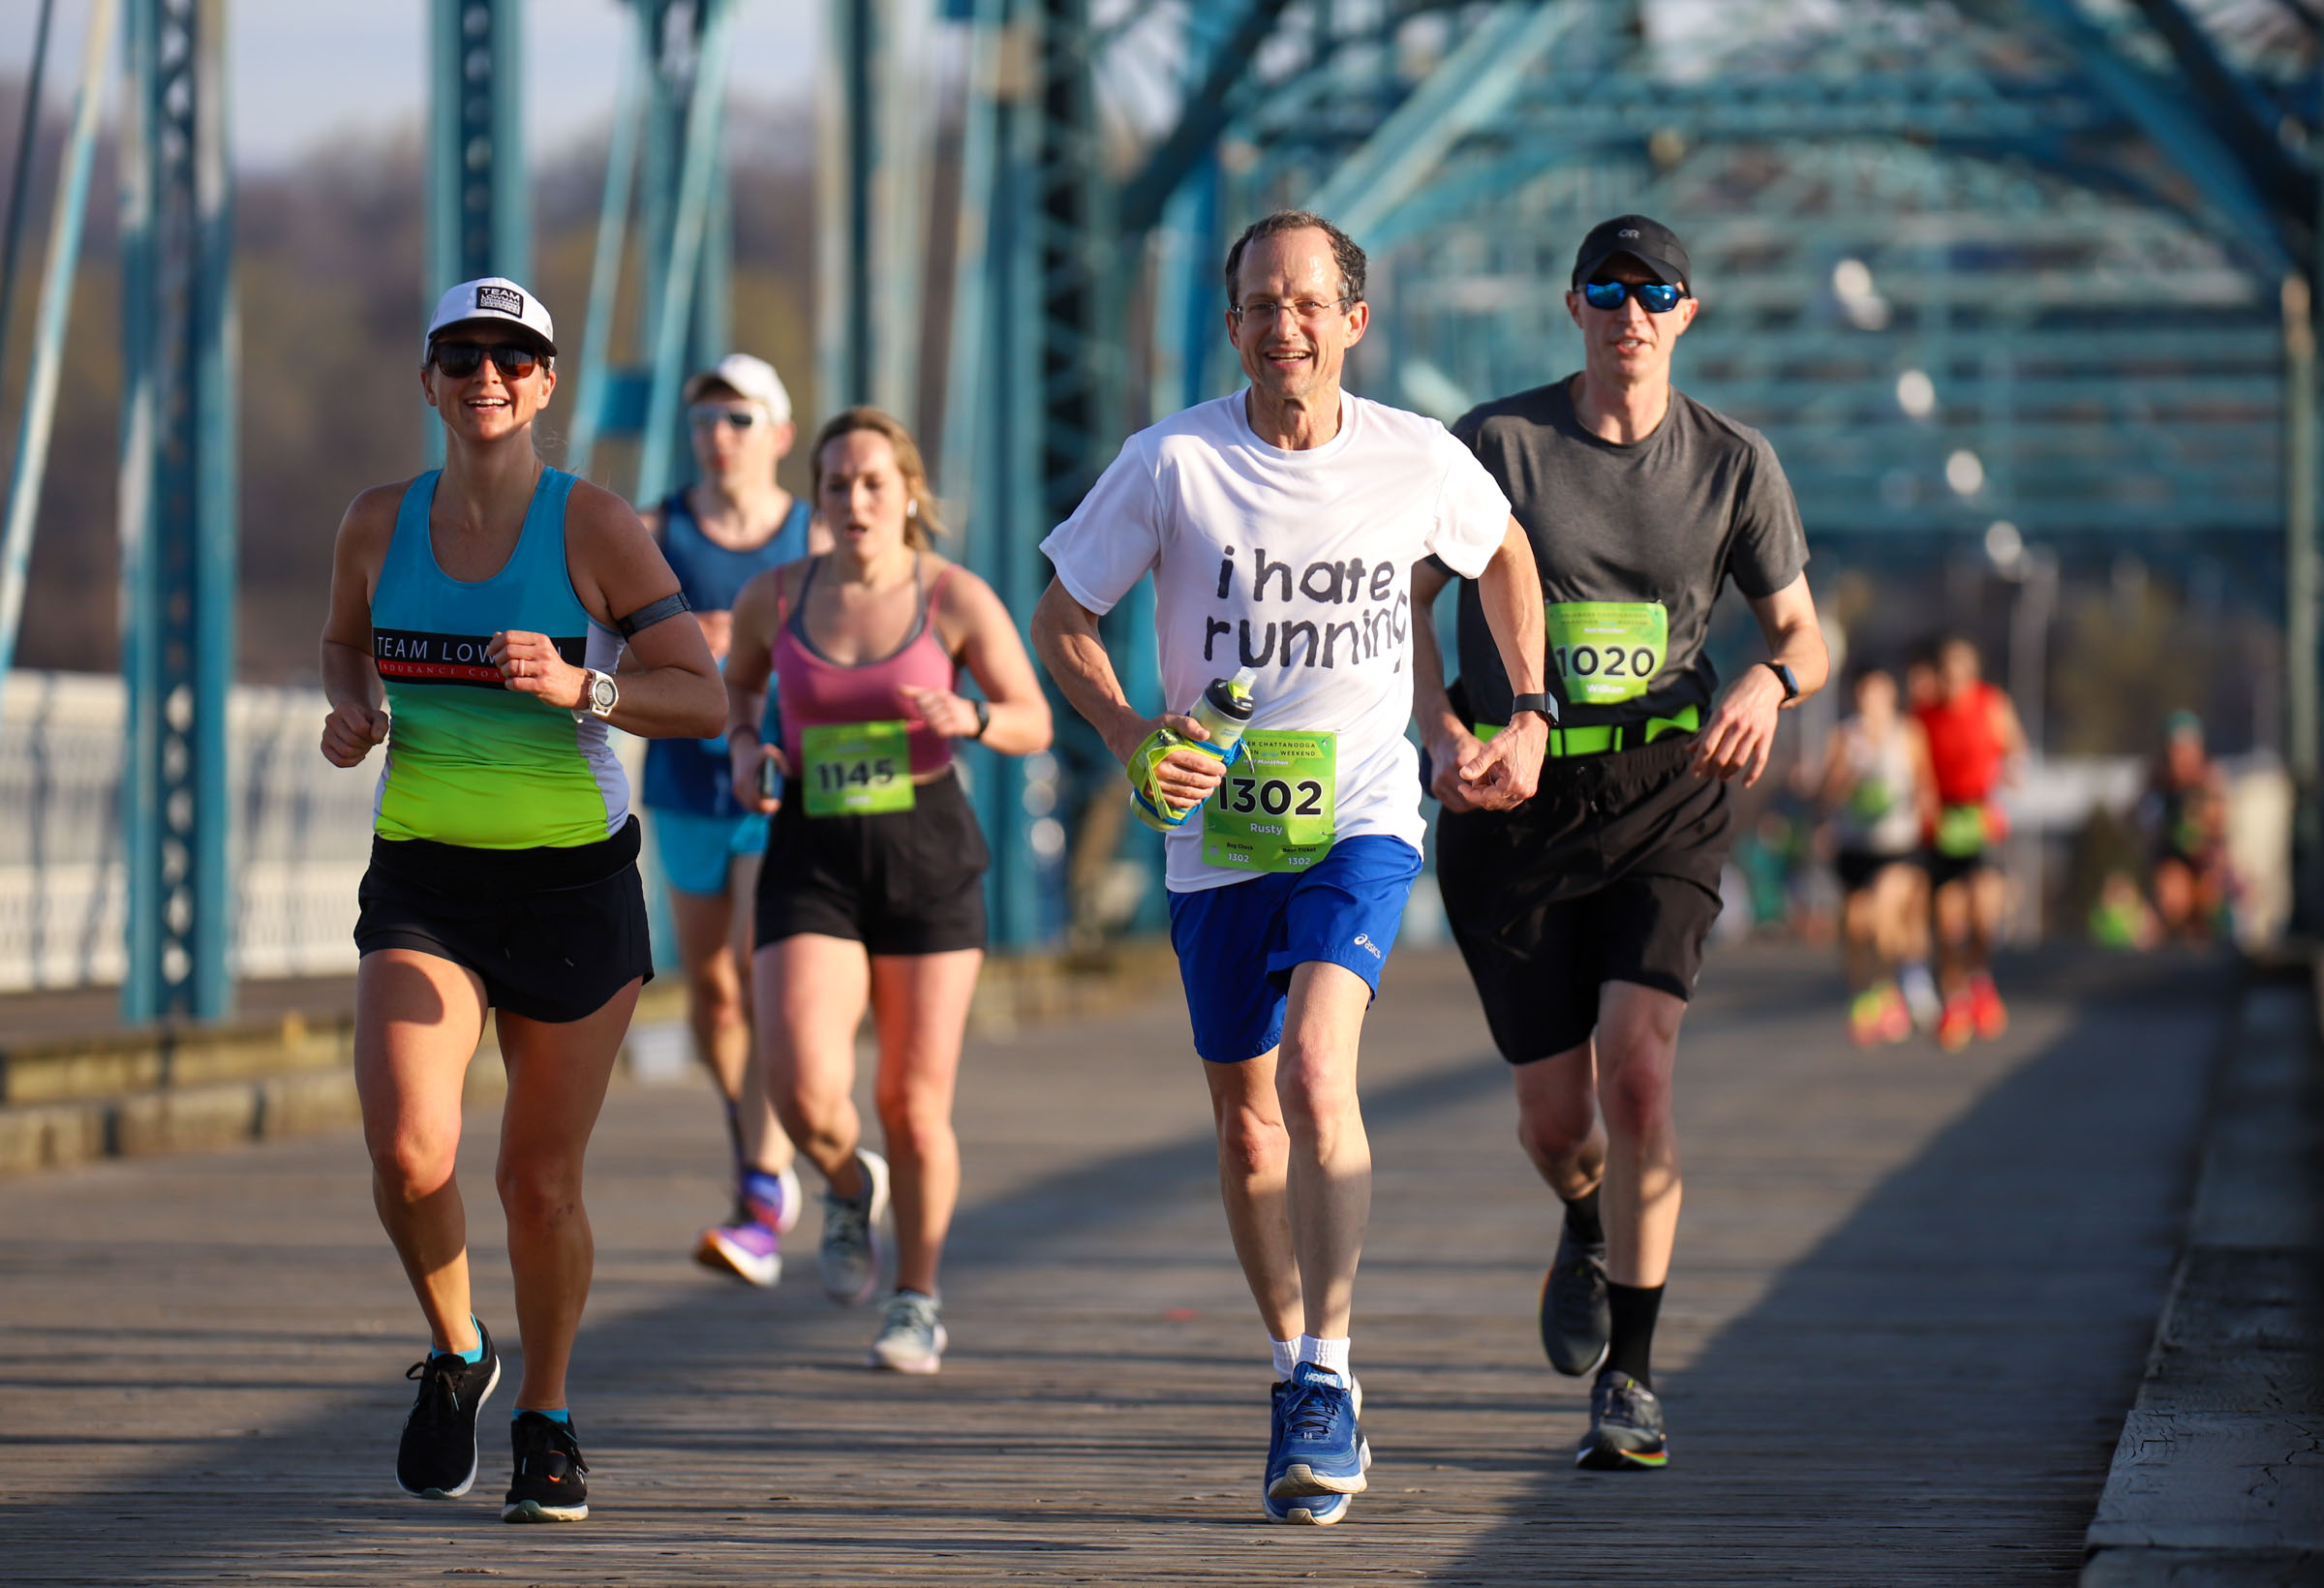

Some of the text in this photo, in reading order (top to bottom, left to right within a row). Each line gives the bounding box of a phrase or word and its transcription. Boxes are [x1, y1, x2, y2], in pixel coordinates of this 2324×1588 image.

[481, 288, 520, 300] TEAM
[1217, 545, 1394, 604] i hate
[1204, 590, 1408, 674] running
[378, 636, 428, 659] TEAM
[1555, 646, 1655, 678] 1020
[817, 758, 896, 793] 1145
[1219, 776, 1322, 815] 1302
[1250, 823, 1283, 835] Rusty
[1229, 853, 1249, 863] 1302
[1364, 939, 1381, 959] asics
